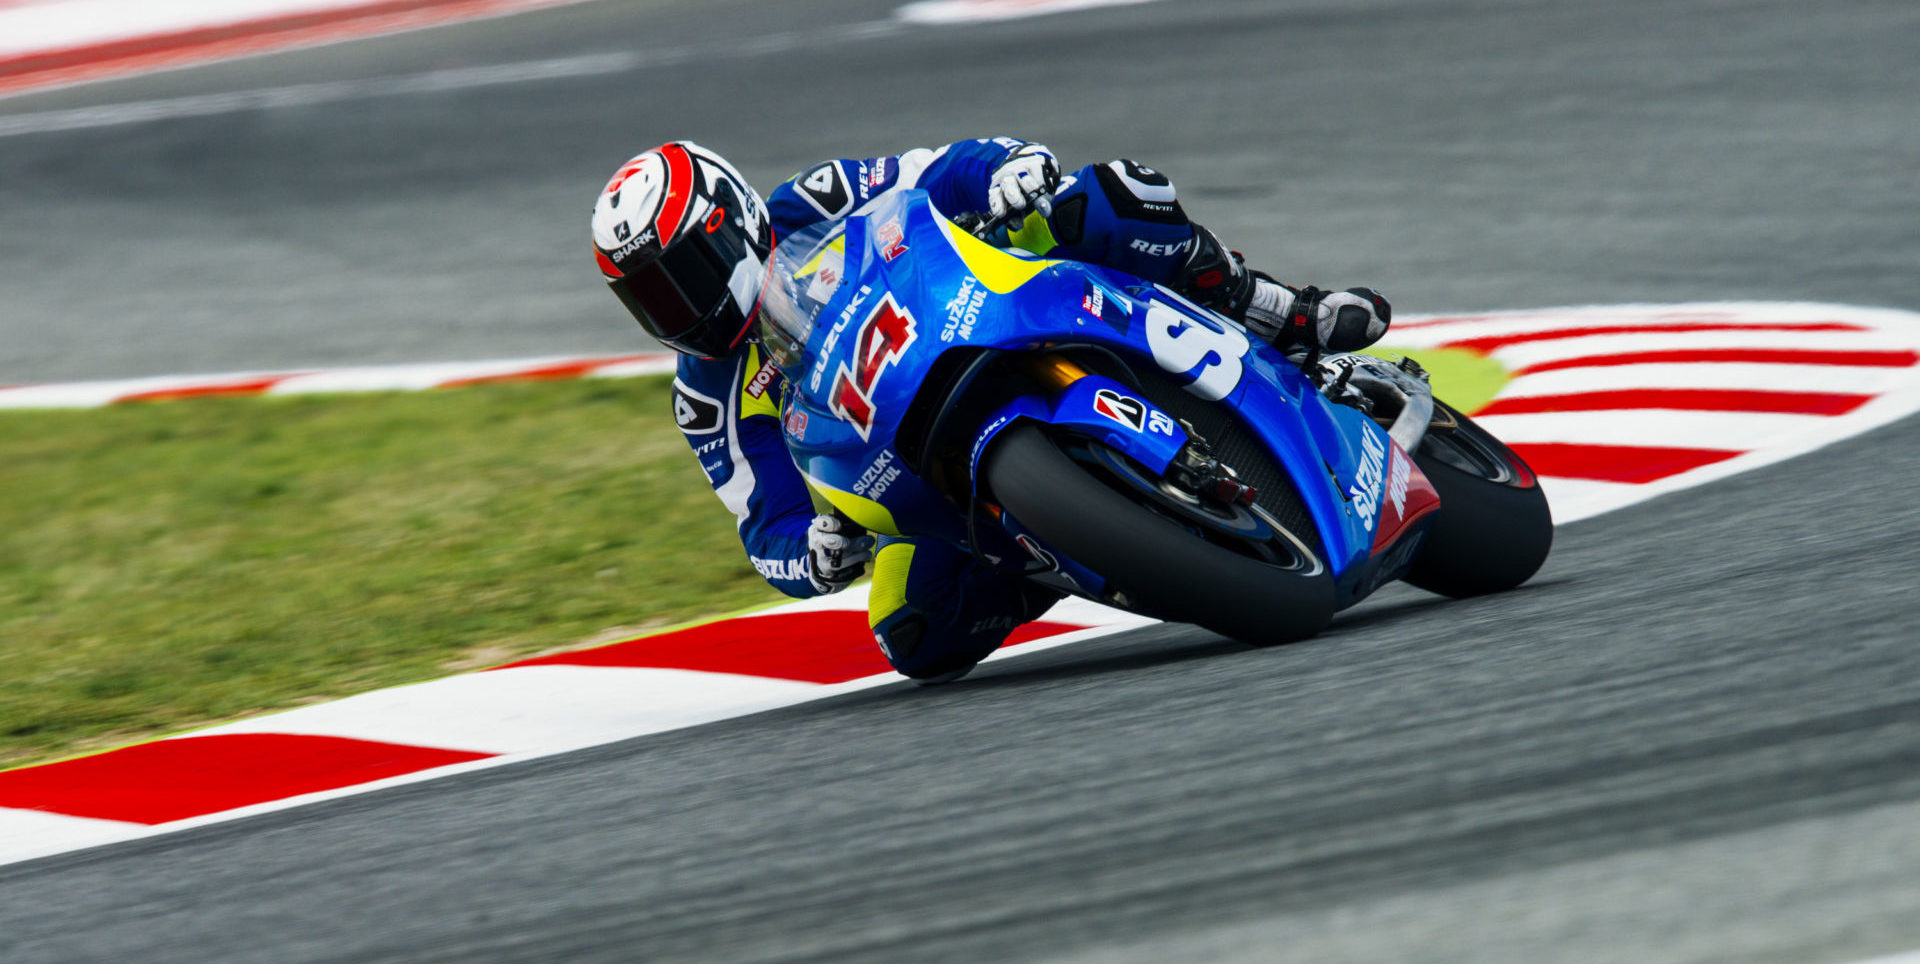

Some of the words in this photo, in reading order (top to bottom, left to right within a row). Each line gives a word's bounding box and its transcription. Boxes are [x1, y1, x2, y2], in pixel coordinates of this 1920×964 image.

[612, 229, 656, 263] SHARK
[809, 284, 873, 395] SUZUKI
[940, 276, 977, 344] SUZUKI
[956, 289, 988, 342] MOTUL
[827, 290, 918, 444] 14
[852, 449, 895, 496] SUZUKI
[868, 467, 901, 501] MOTUL
[1350, 419, 1386, 532] SUZUKI
